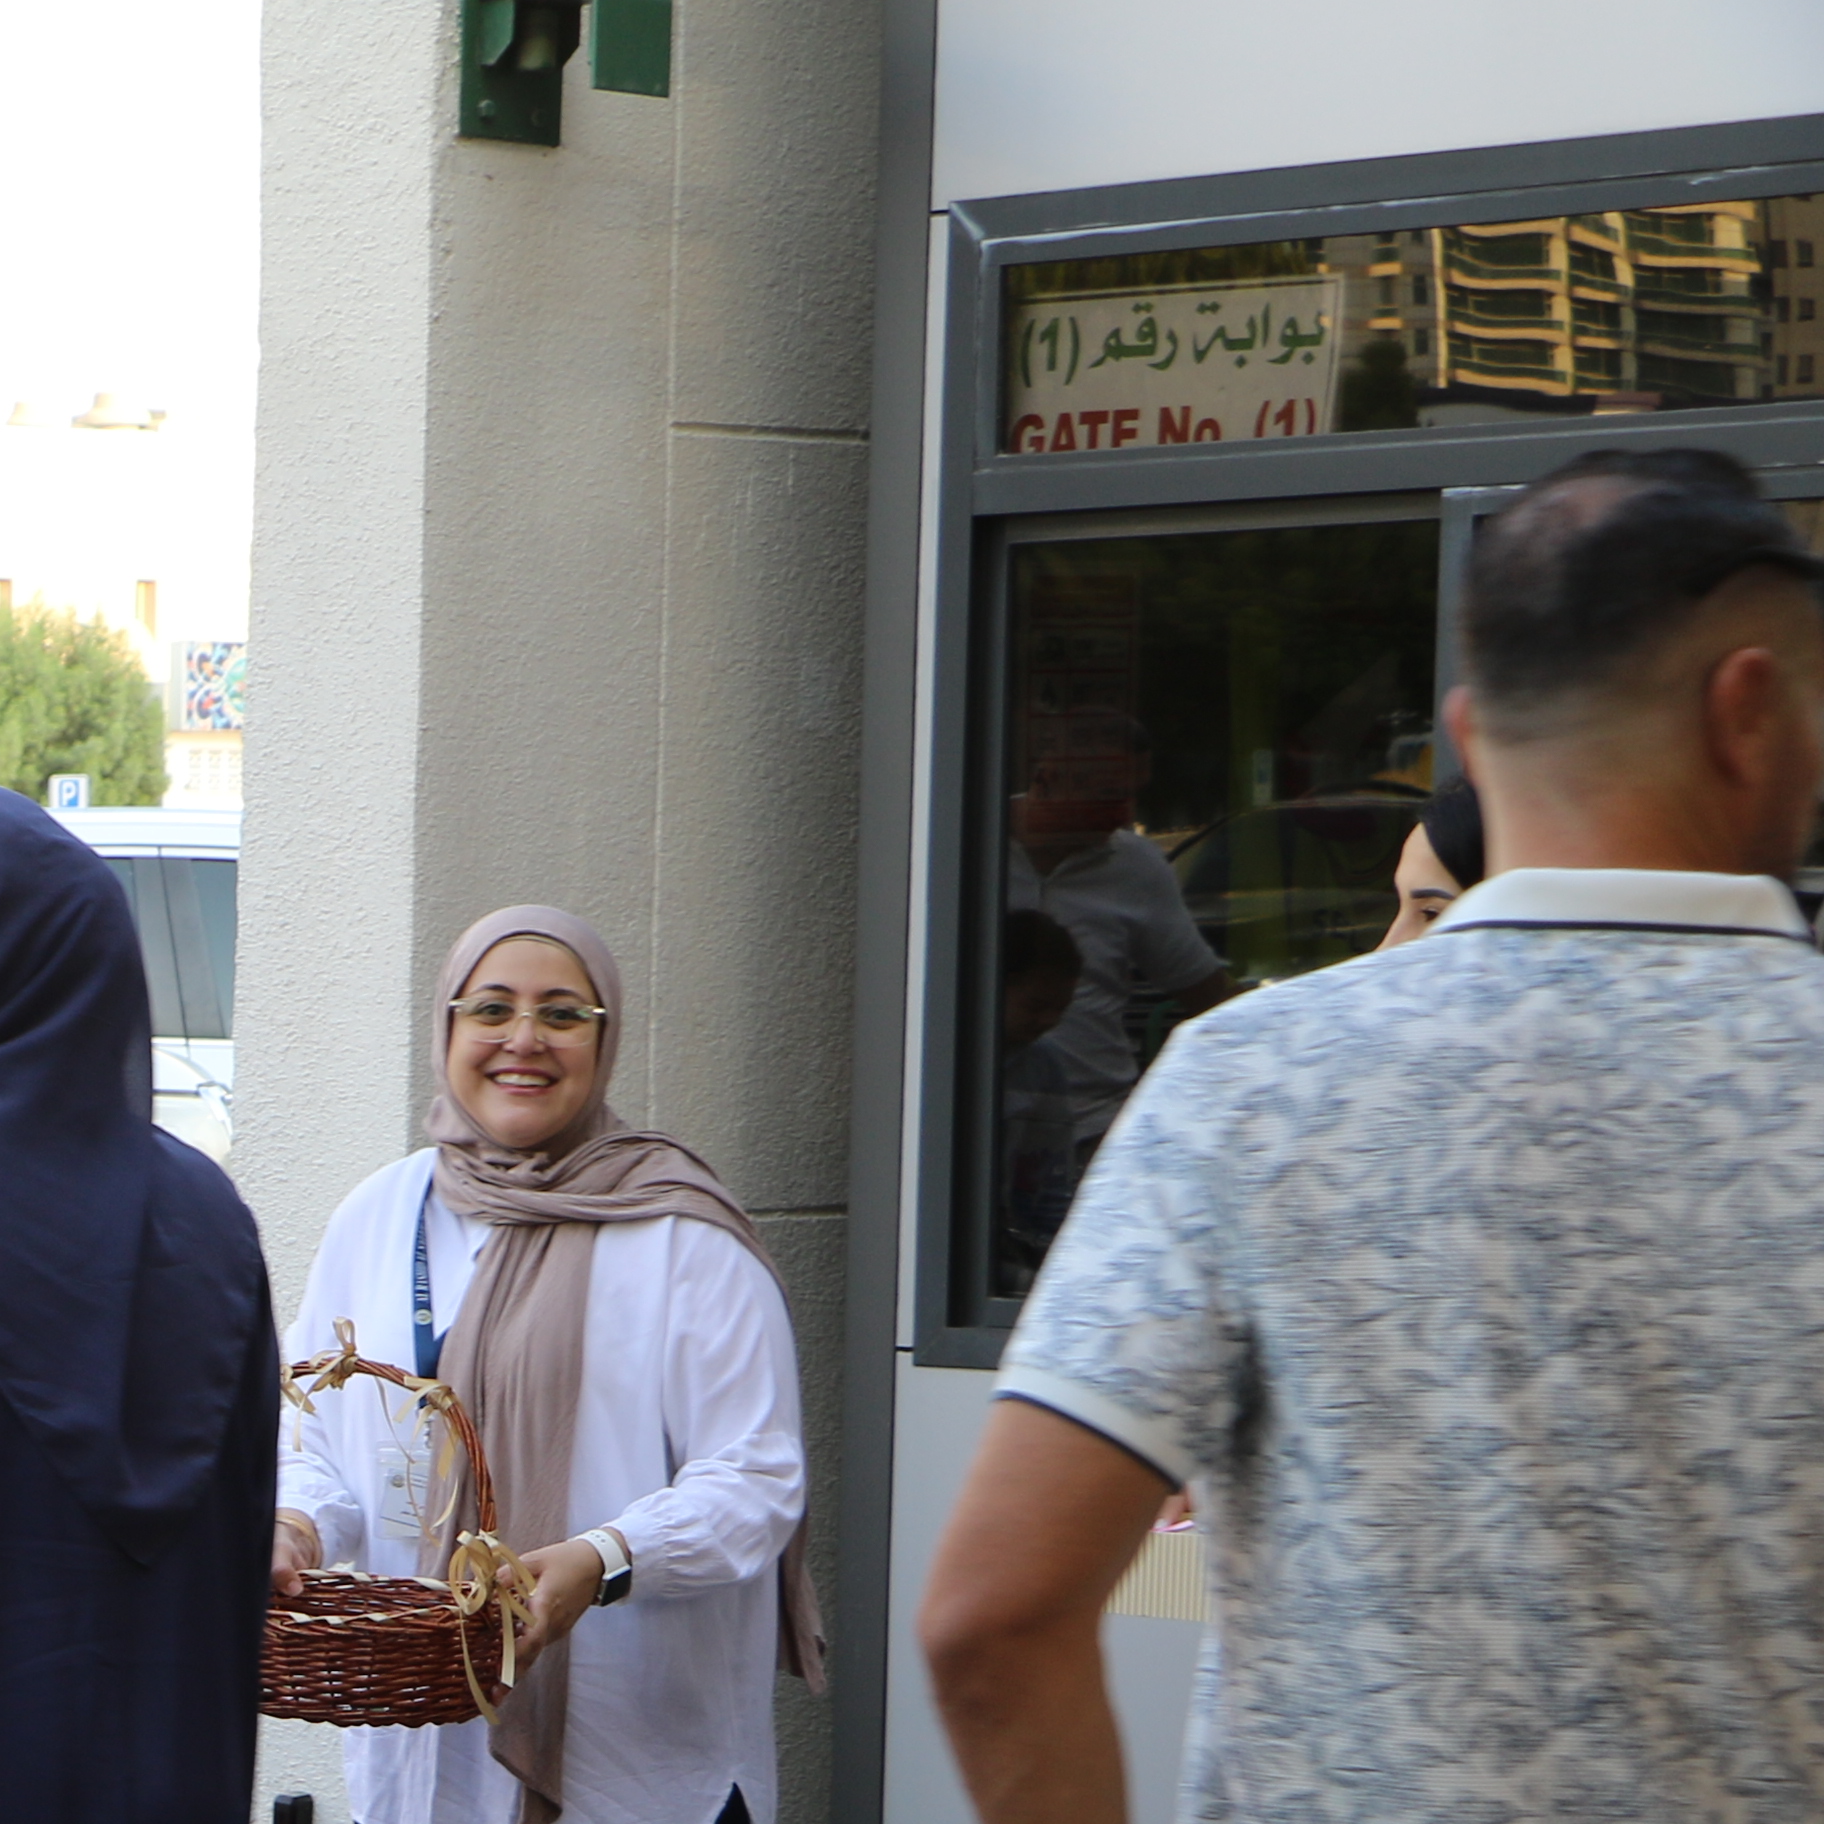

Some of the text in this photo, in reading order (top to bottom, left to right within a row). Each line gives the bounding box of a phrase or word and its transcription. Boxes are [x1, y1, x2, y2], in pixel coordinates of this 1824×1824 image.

[1020, 302, 1326, 388] بوابة رقم (1)
[1011, 409, 1140, 453] GATE
[1254, 398, 1317, 438] (1)
[62, 781, 76, 806] P
